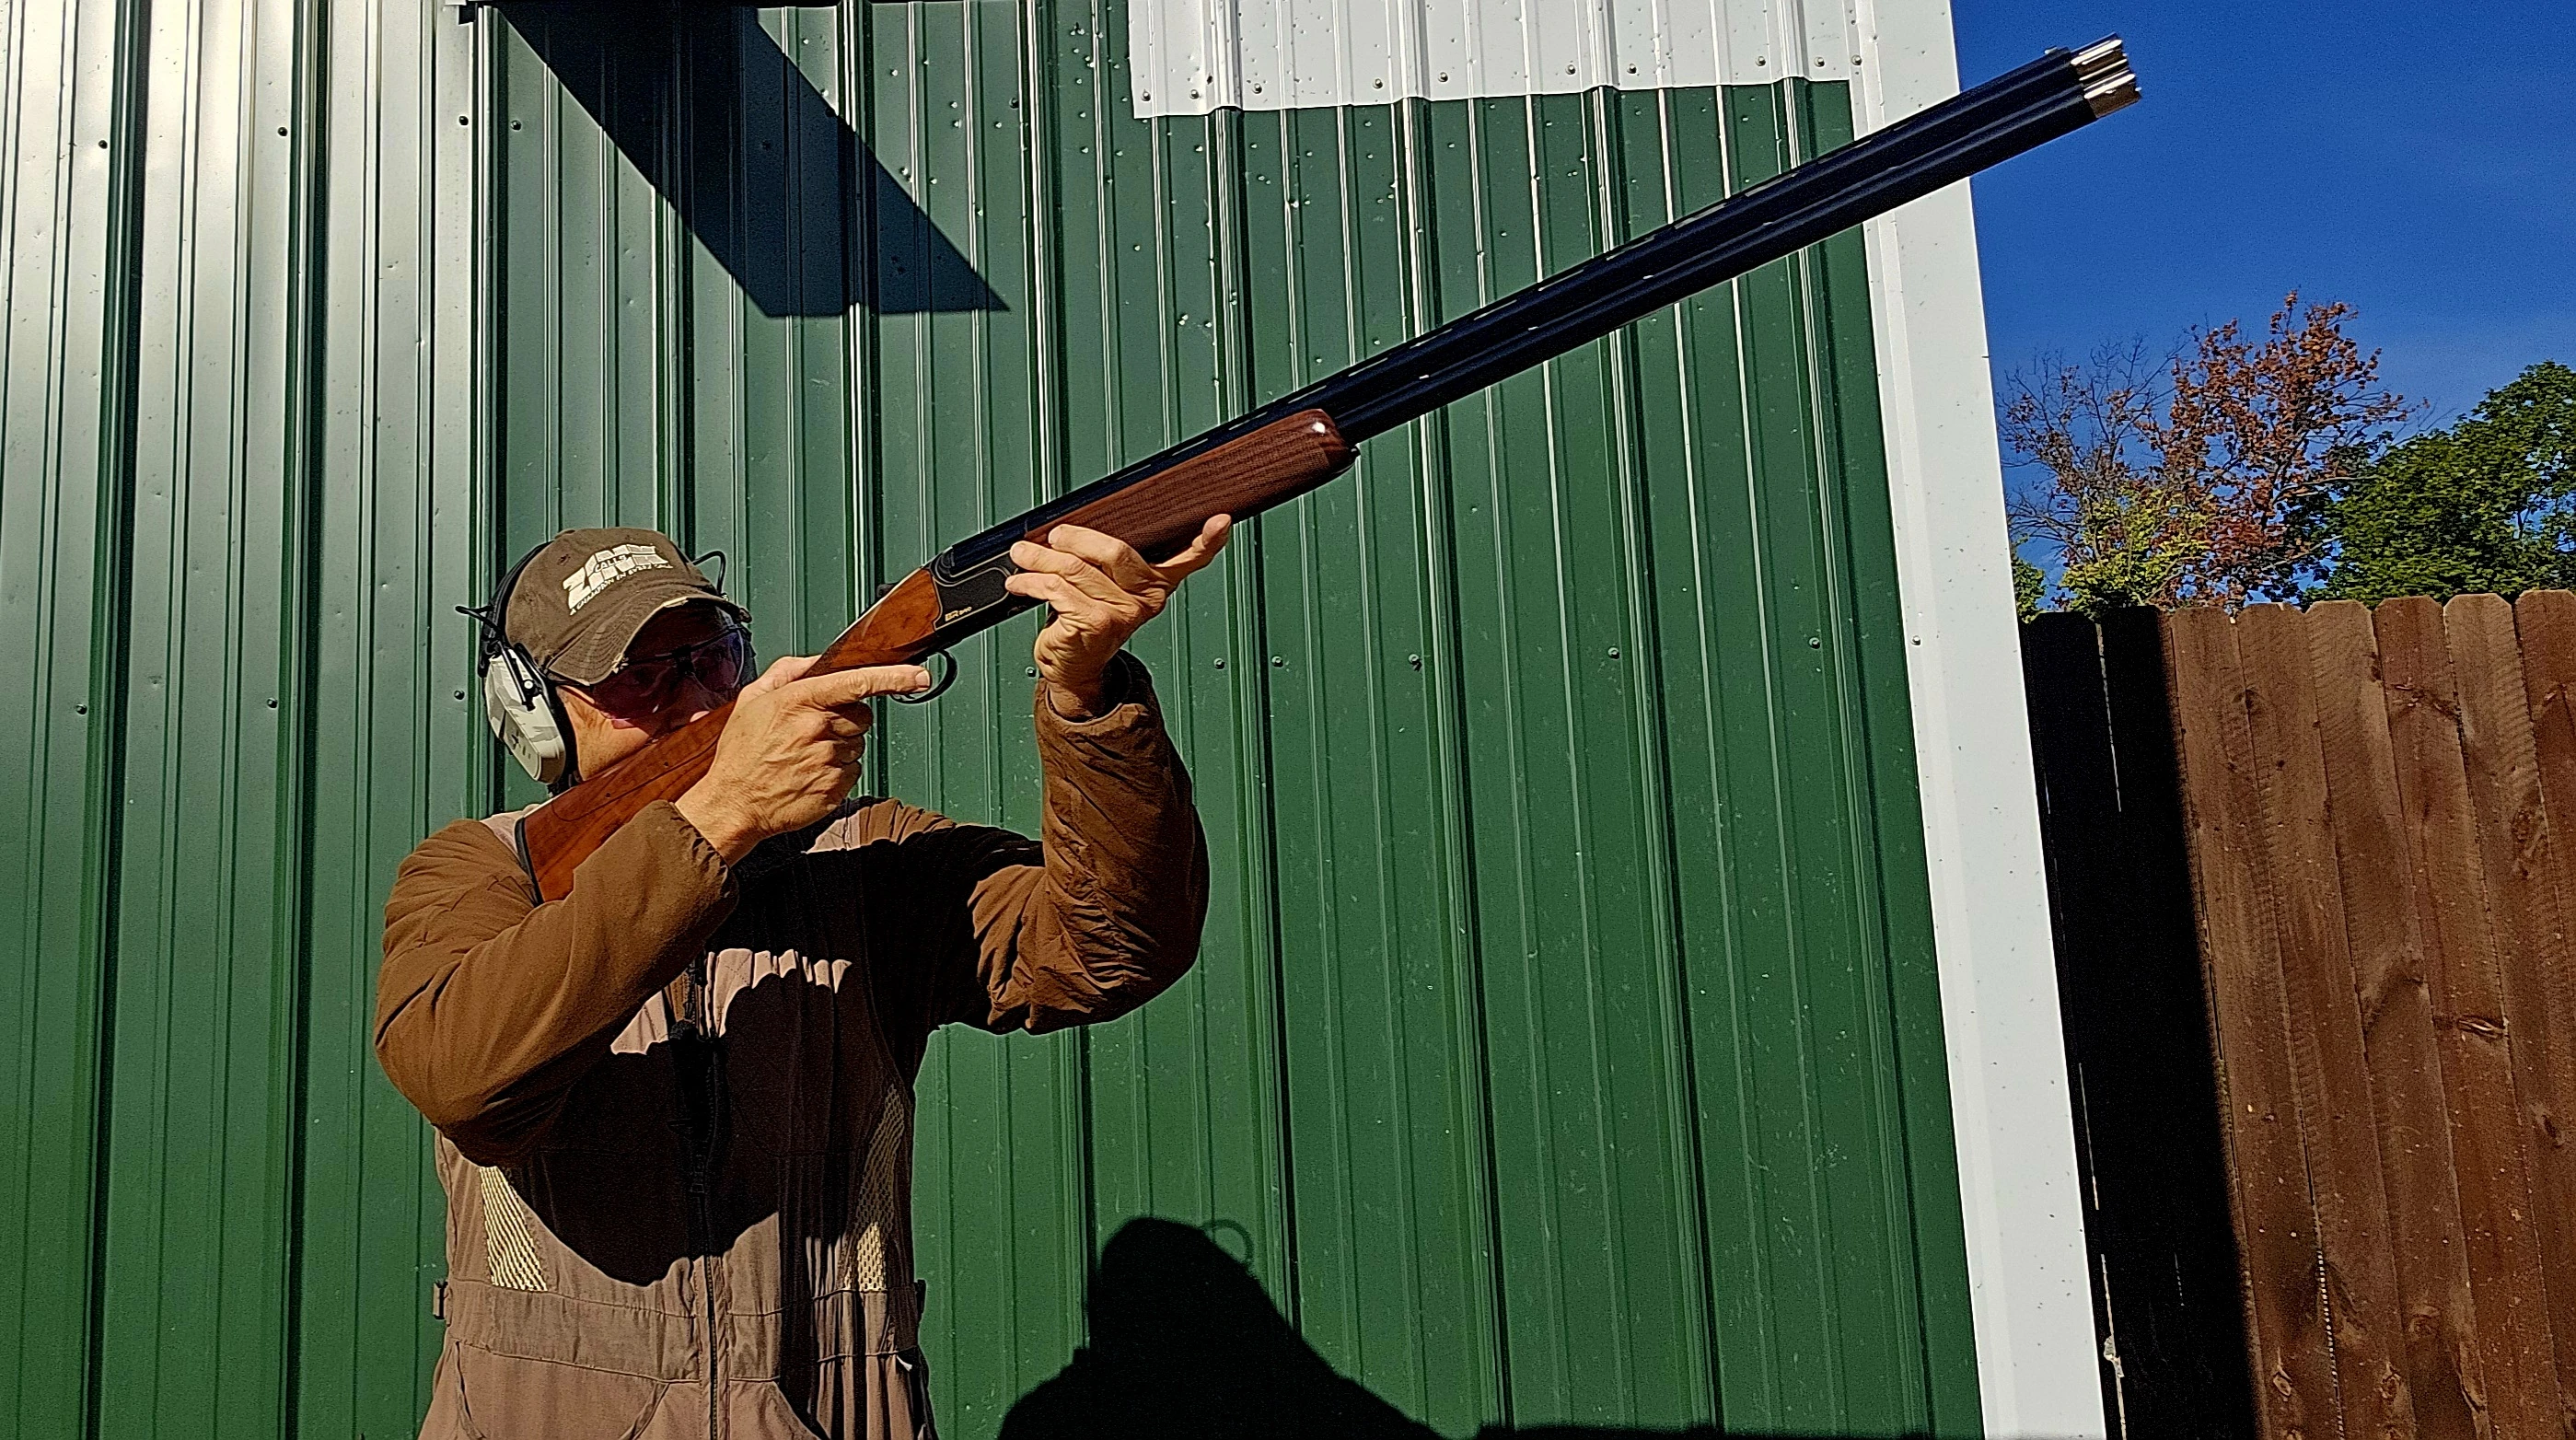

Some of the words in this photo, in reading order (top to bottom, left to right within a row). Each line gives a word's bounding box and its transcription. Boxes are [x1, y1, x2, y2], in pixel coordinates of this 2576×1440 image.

[563, 544, 669, 610] ZINK
[594, 554, 627, 573] CALLS
[576, 577, 615, 610] CHAMPION
[616, 572, 627, 581] IN
